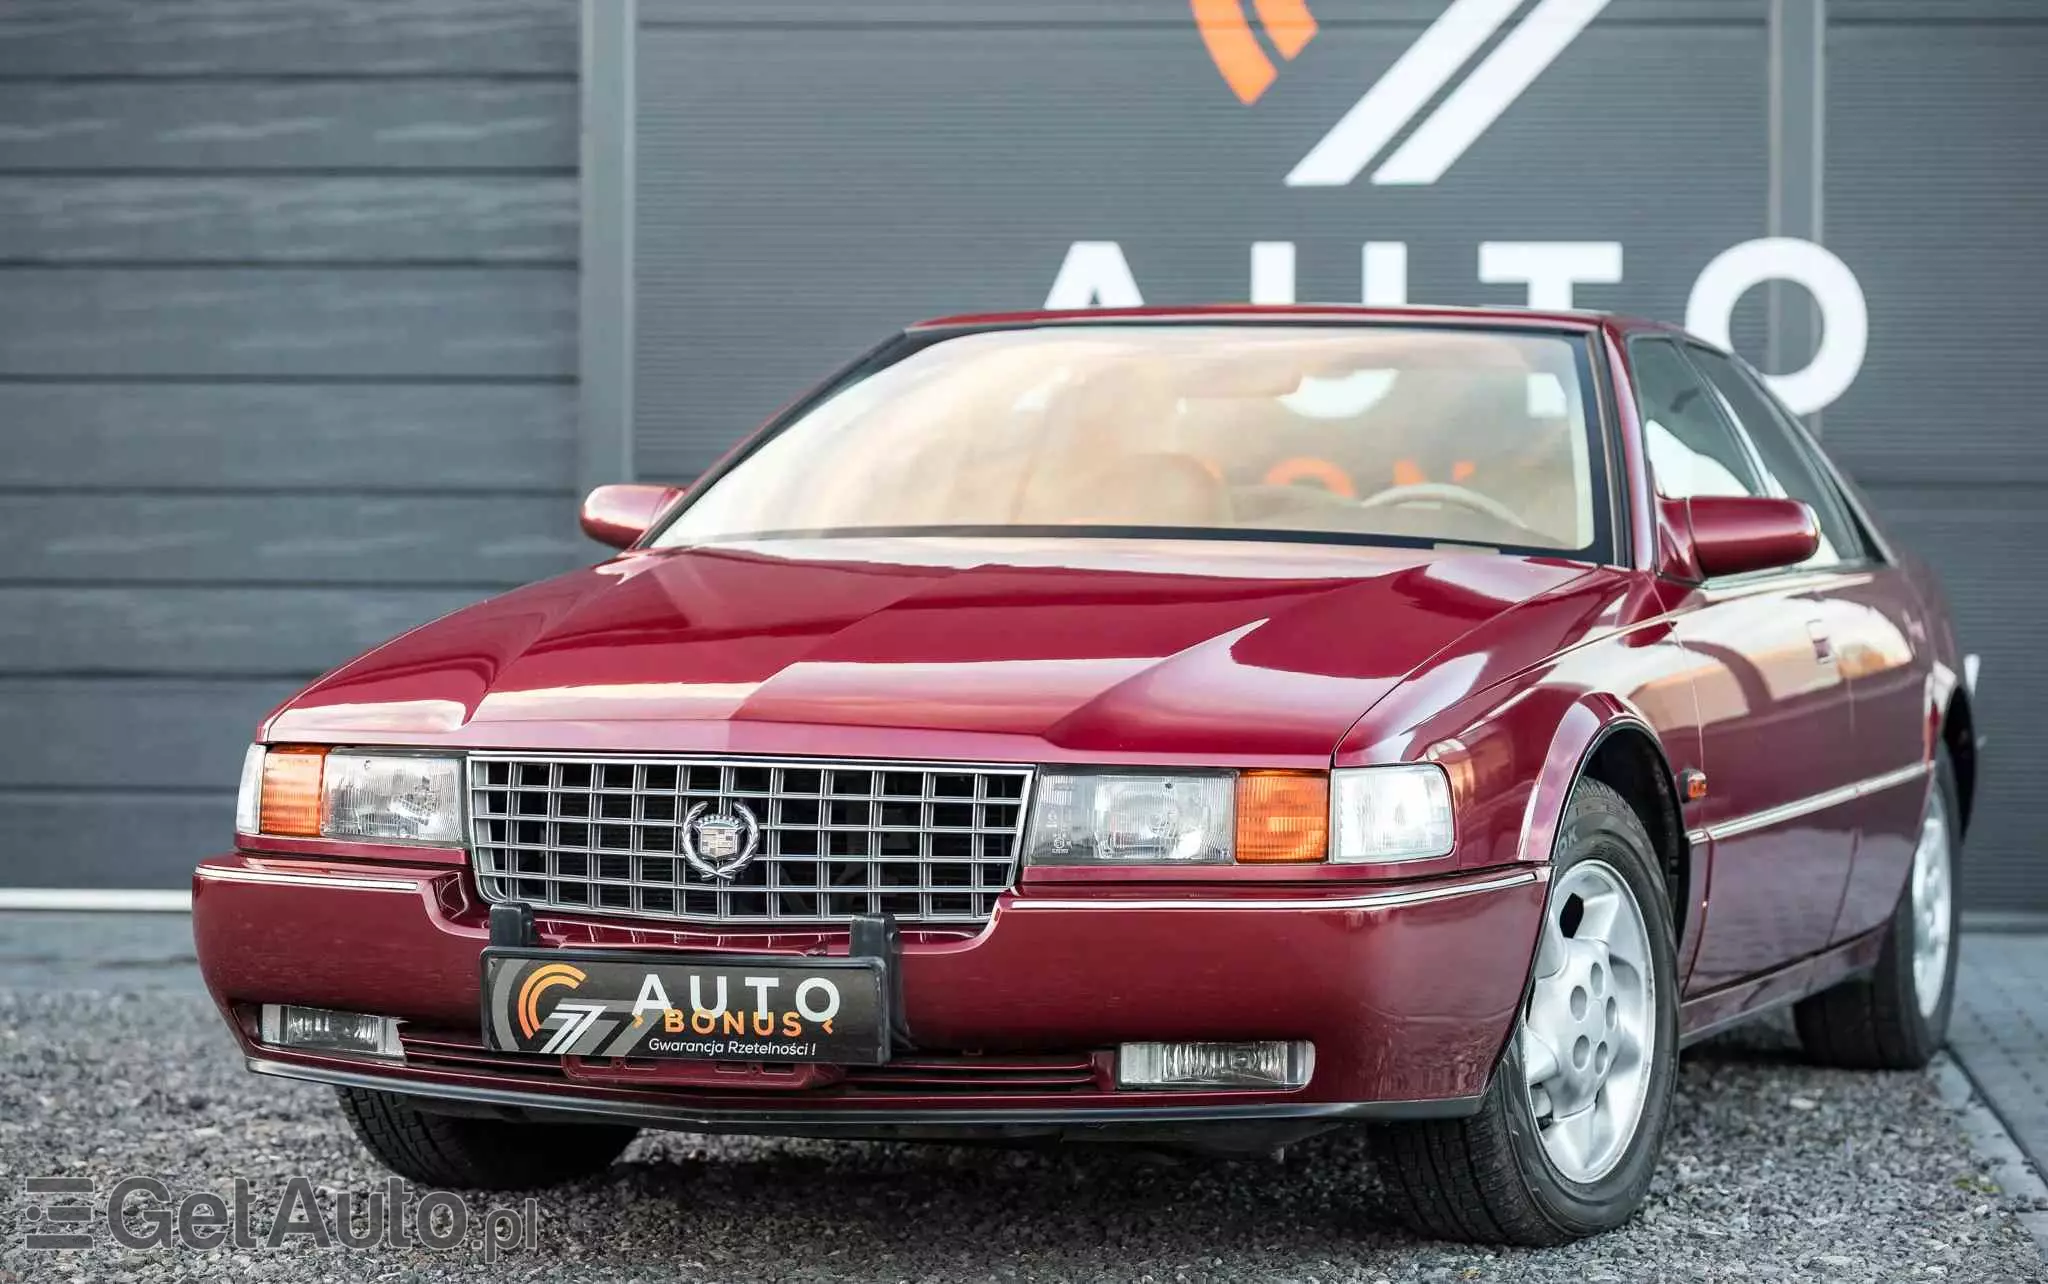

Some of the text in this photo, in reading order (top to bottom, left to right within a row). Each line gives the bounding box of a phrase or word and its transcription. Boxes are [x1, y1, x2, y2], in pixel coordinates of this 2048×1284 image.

[632, 973, 840, 1023] AUTO
[665, 1009, 802, 1037] BONUS
[648, 1038, 725, 1055] Gwarancja
[728, 1041, 809, 1056] Rzetelności
